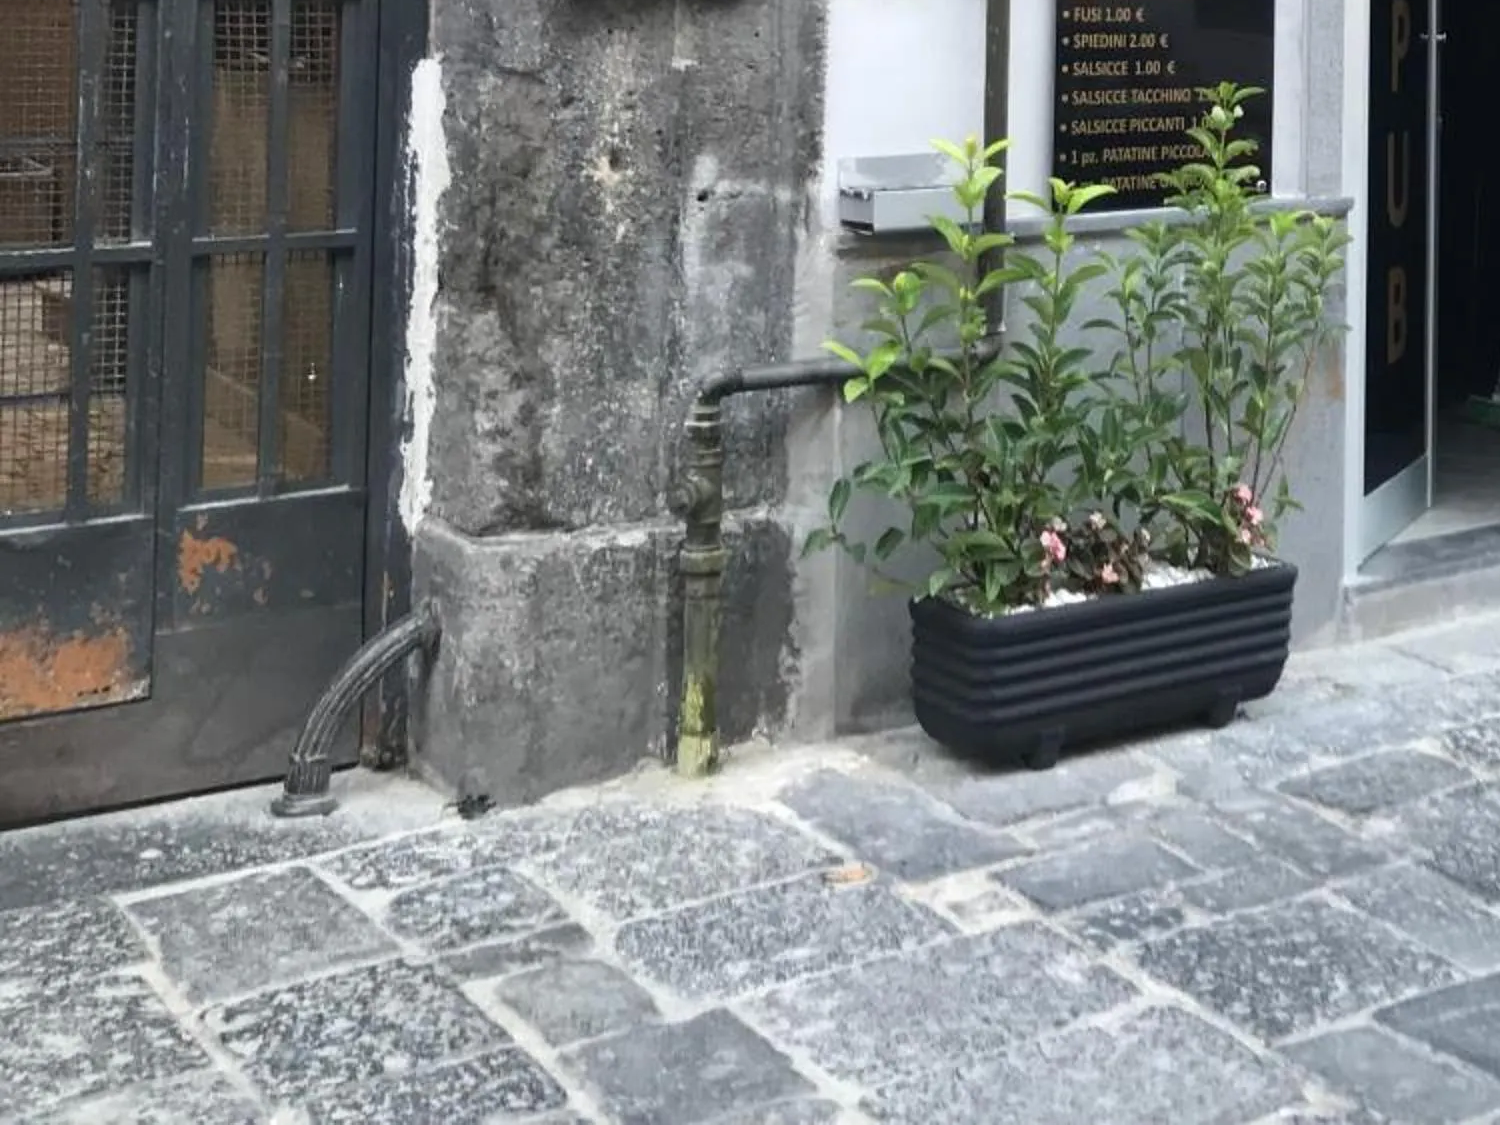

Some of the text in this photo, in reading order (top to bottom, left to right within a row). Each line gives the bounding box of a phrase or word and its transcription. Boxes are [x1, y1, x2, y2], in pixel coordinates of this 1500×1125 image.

[1106, 8, 1131, 22] 1.00
[1136, 8, 1144, 22] €
[1074, 34, 1169, 49] SPIEDINI 2.00 €
[1073, 61, 1176, 77] SALSICCE 1.00 €
[1072, 89, 1127, 105] SALSICCE
[1131, 88, 1192, 104] TACCHINO
[1071, 119, 1127, 135] SALSICCE
[1128, 118, 1185, 133] PICCANTI
[1103, 146, 1158, 163] PATATINE
